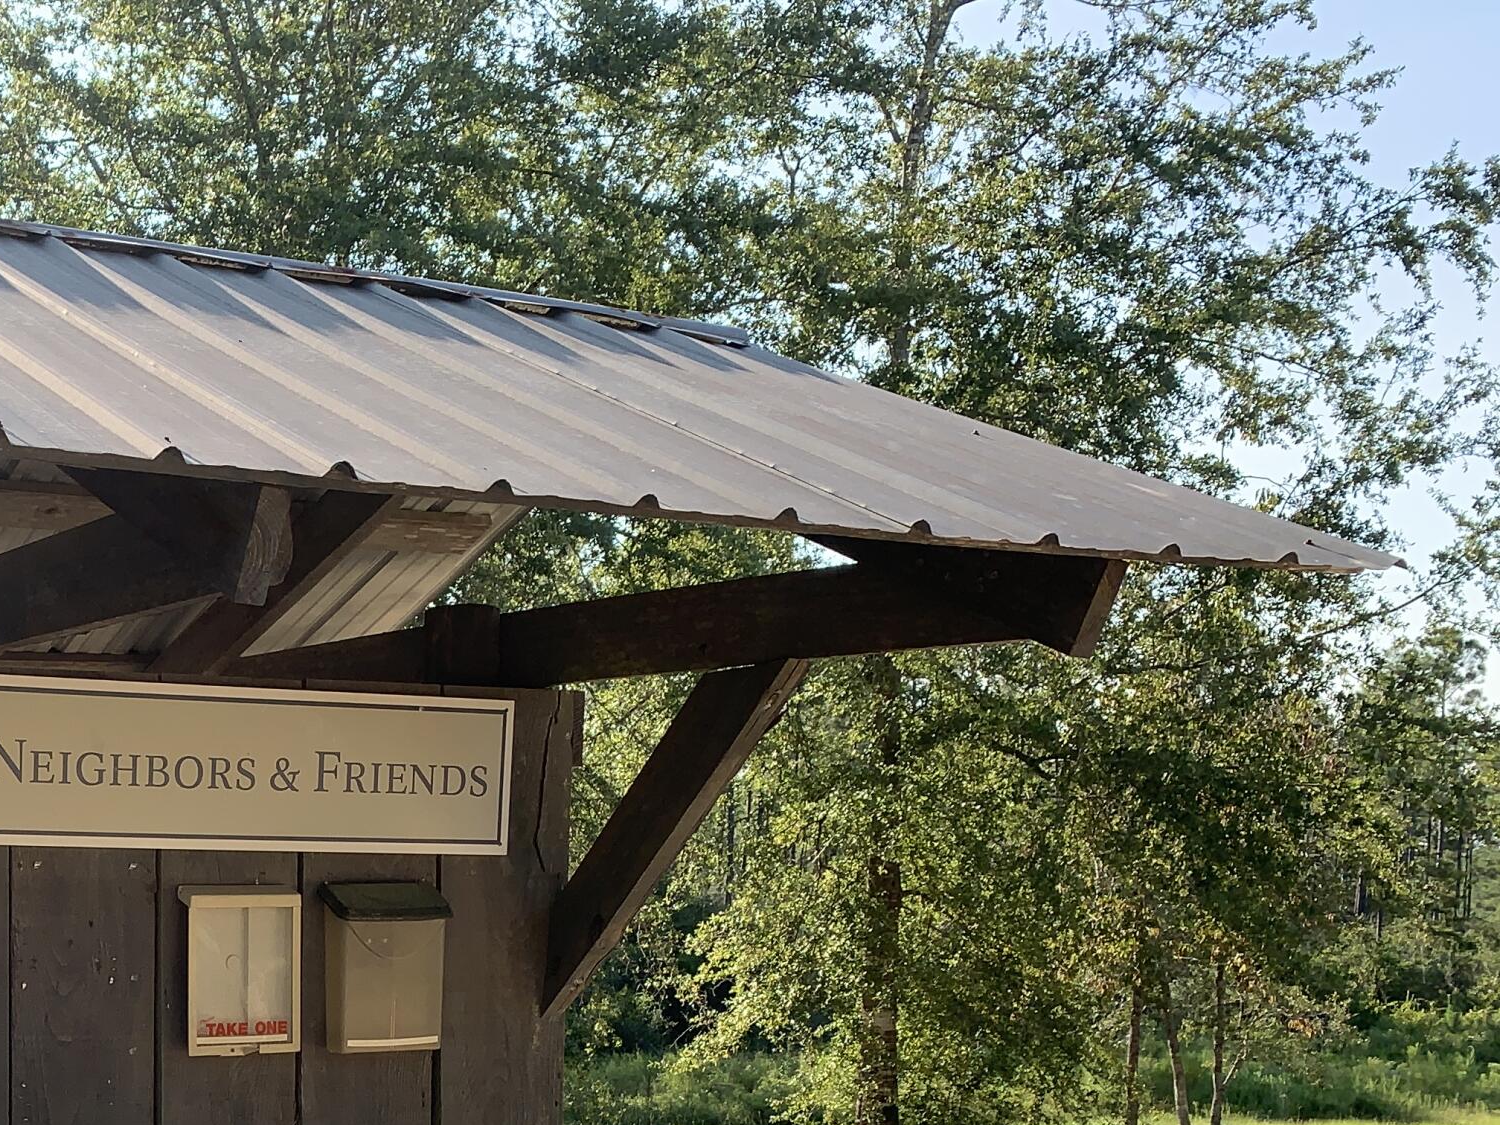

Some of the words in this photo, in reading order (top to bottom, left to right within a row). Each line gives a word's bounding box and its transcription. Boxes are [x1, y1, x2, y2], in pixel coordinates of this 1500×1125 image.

[270, 756, 301, 793] &
[313, 750, 489, 798] FRIENDS
[206, 1022, 248, 1036] TAKE
[255, 1020, 287, 1034] ONE
